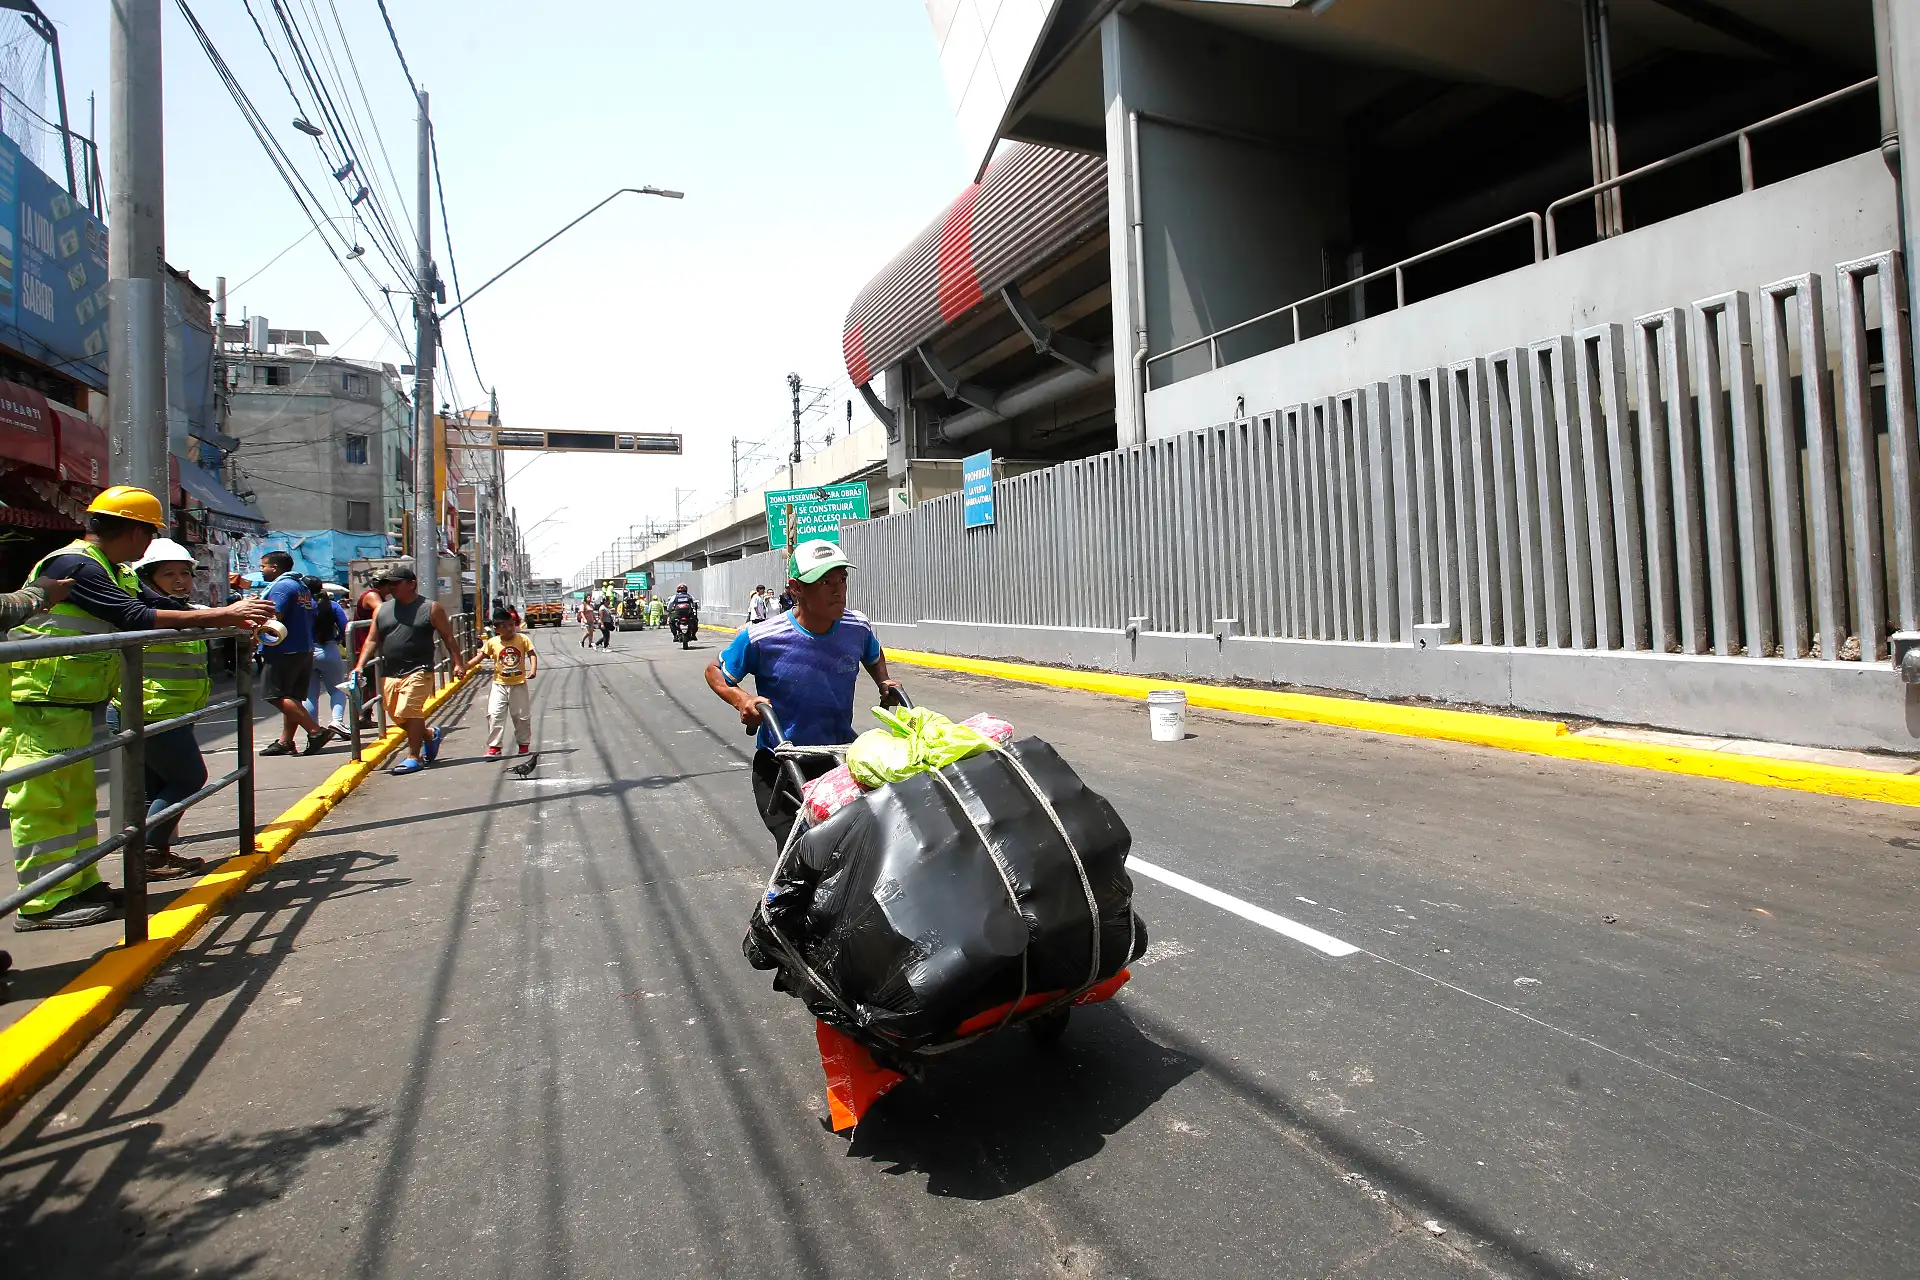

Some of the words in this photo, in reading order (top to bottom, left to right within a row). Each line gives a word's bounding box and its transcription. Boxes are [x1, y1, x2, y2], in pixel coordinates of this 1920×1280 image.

[22, 202, 33, 245] LA
[34, 211, 55, 259] VIDA
[23, 271, 54, 322] SABOR
[770, 495, 787, 503] ZONA
[788, 492, 819, 502] RESERVA
[841, 489, 861, 497] OBRAS
[781, 505, 797, 516] AUÍ
[799, 506, 807, 514] SE
[809, 501, 853, 513] CONSTRUIRÁ
[778, 518, 786, 526] EL
[797, 515, 811, 524] EVO
[813, 513, 840, 523] ACCESO
[783, 525, 816, 536] ECIÓN
[818, 524, 838, 532] GAMA
